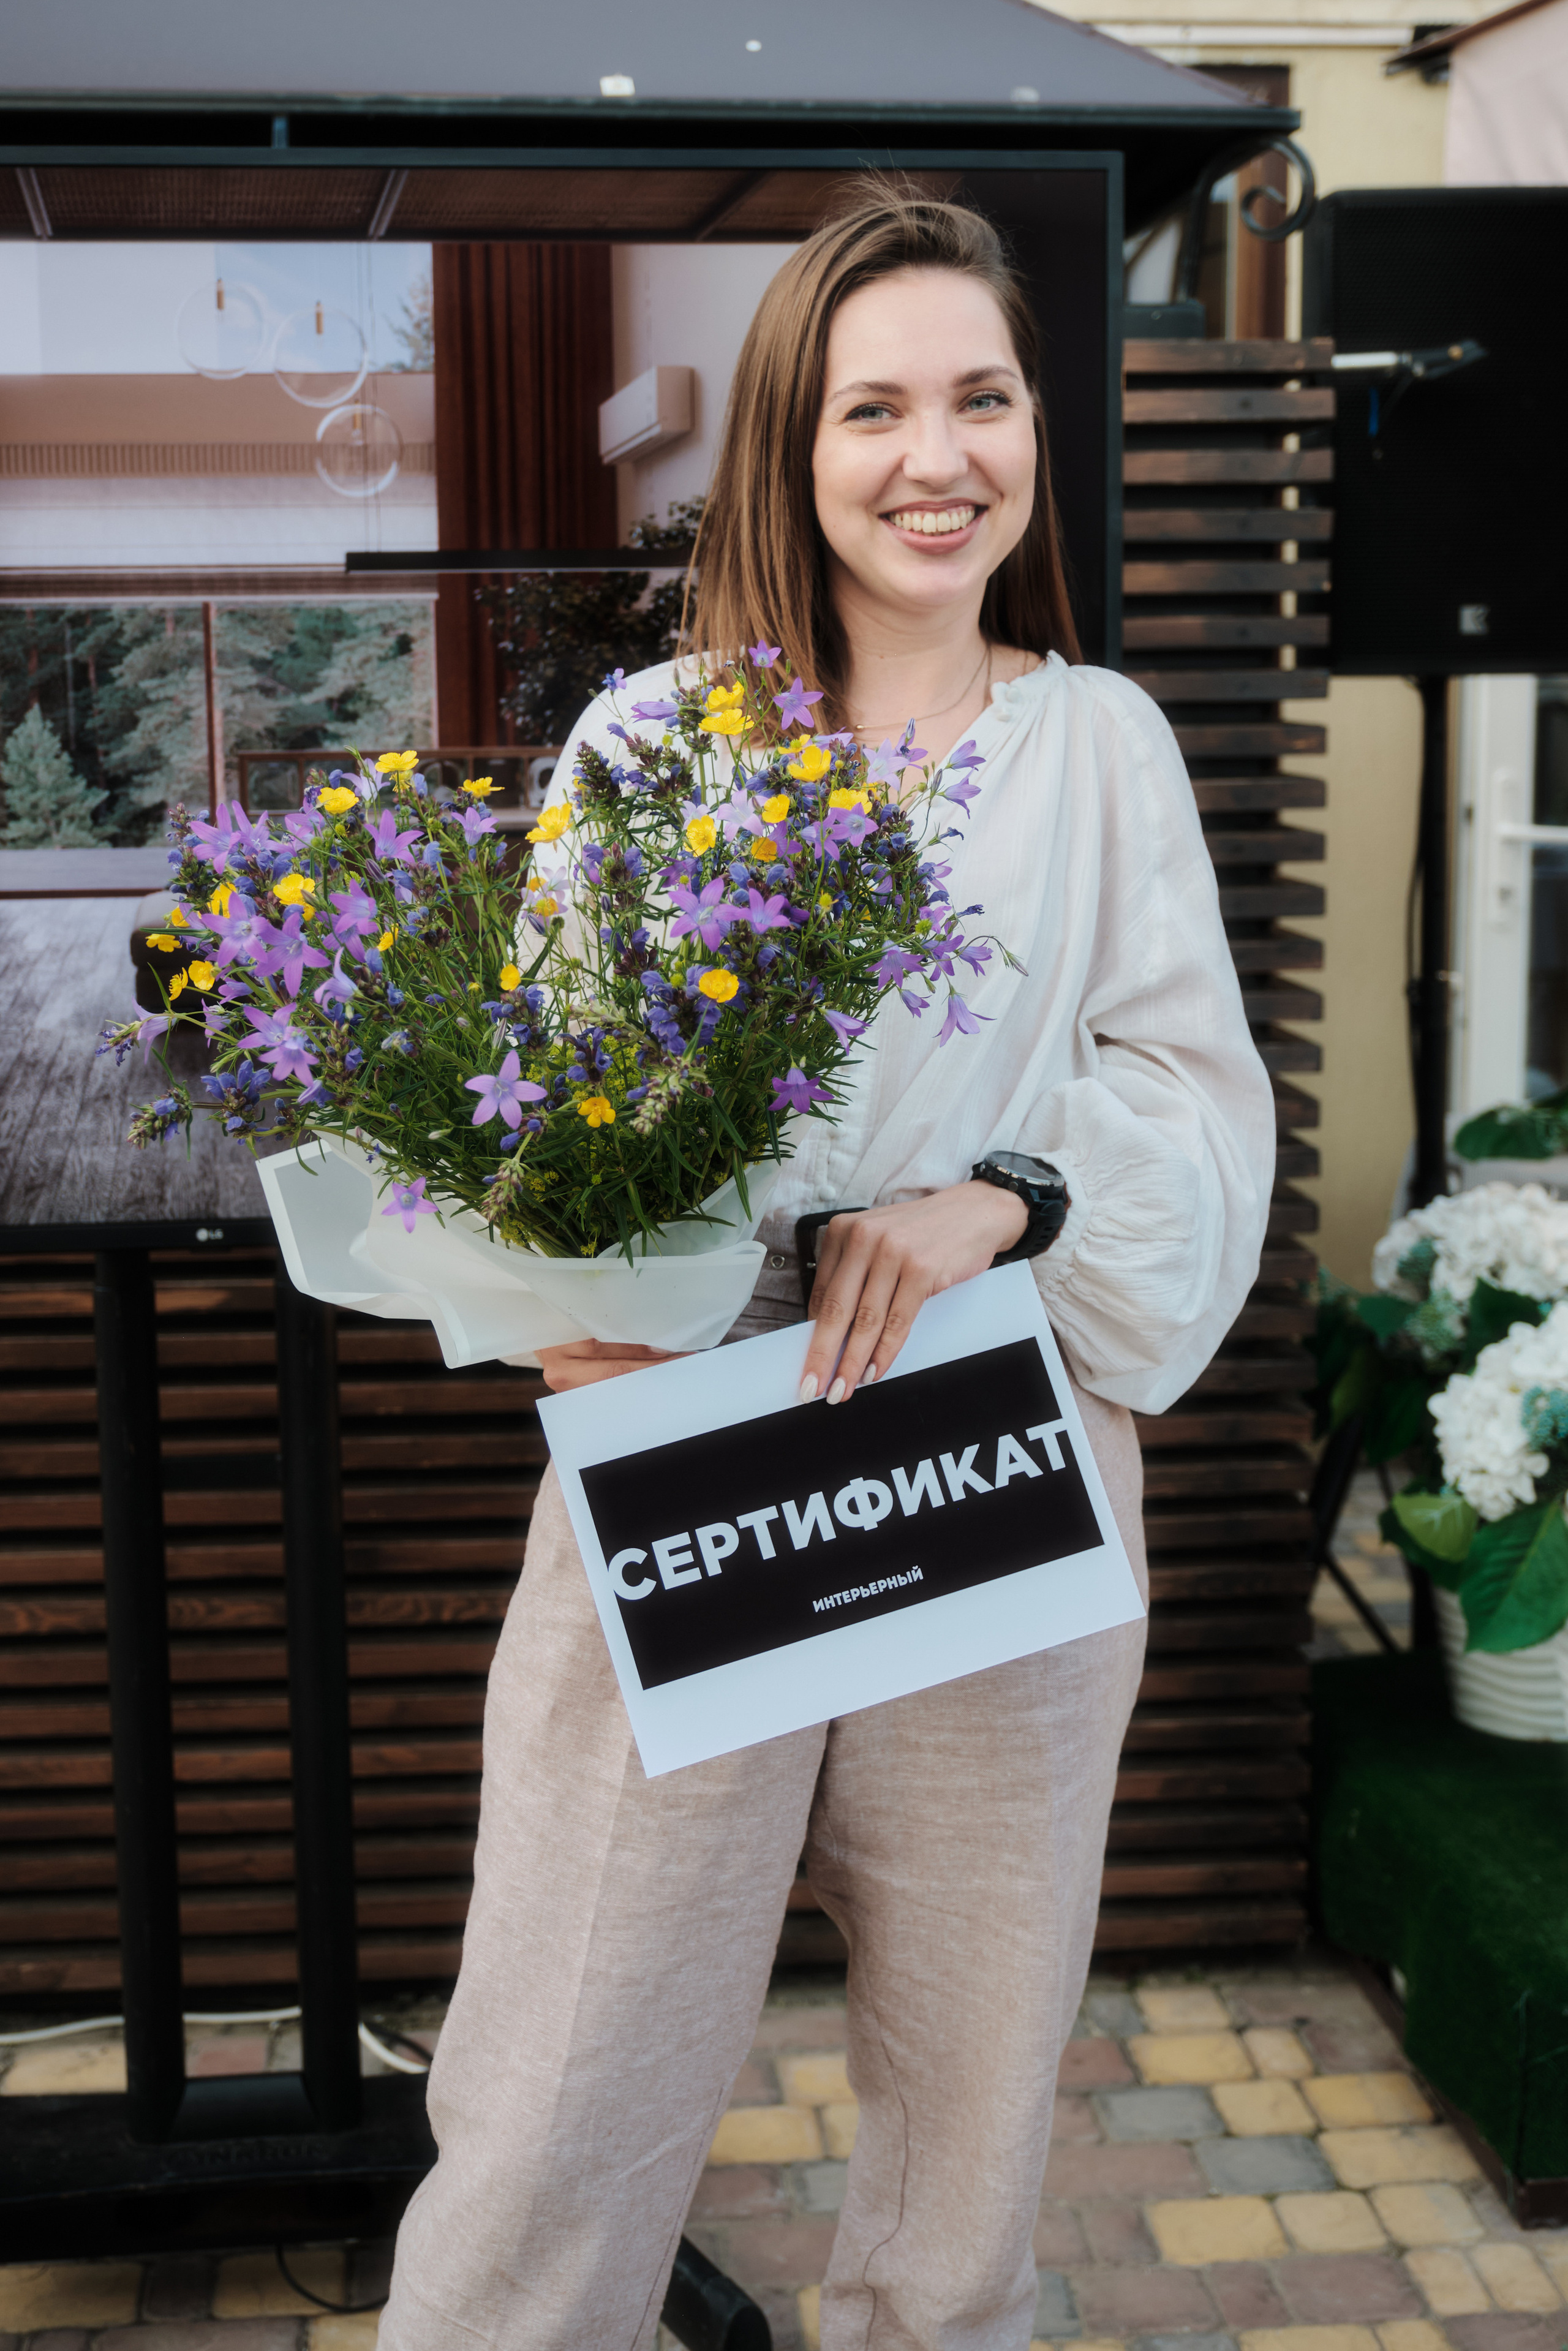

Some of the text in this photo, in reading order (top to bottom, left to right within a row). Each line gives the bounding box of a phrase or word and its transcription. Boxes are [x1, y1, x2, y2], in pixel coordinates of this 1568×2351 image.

[208, 1228, 224, 1240] LG
[607, 1417, 1068, 1601] СЕРТИФИКАТ
[812, 1565, 924, 1613] ИНТЕРЬЕРНЫЙ
